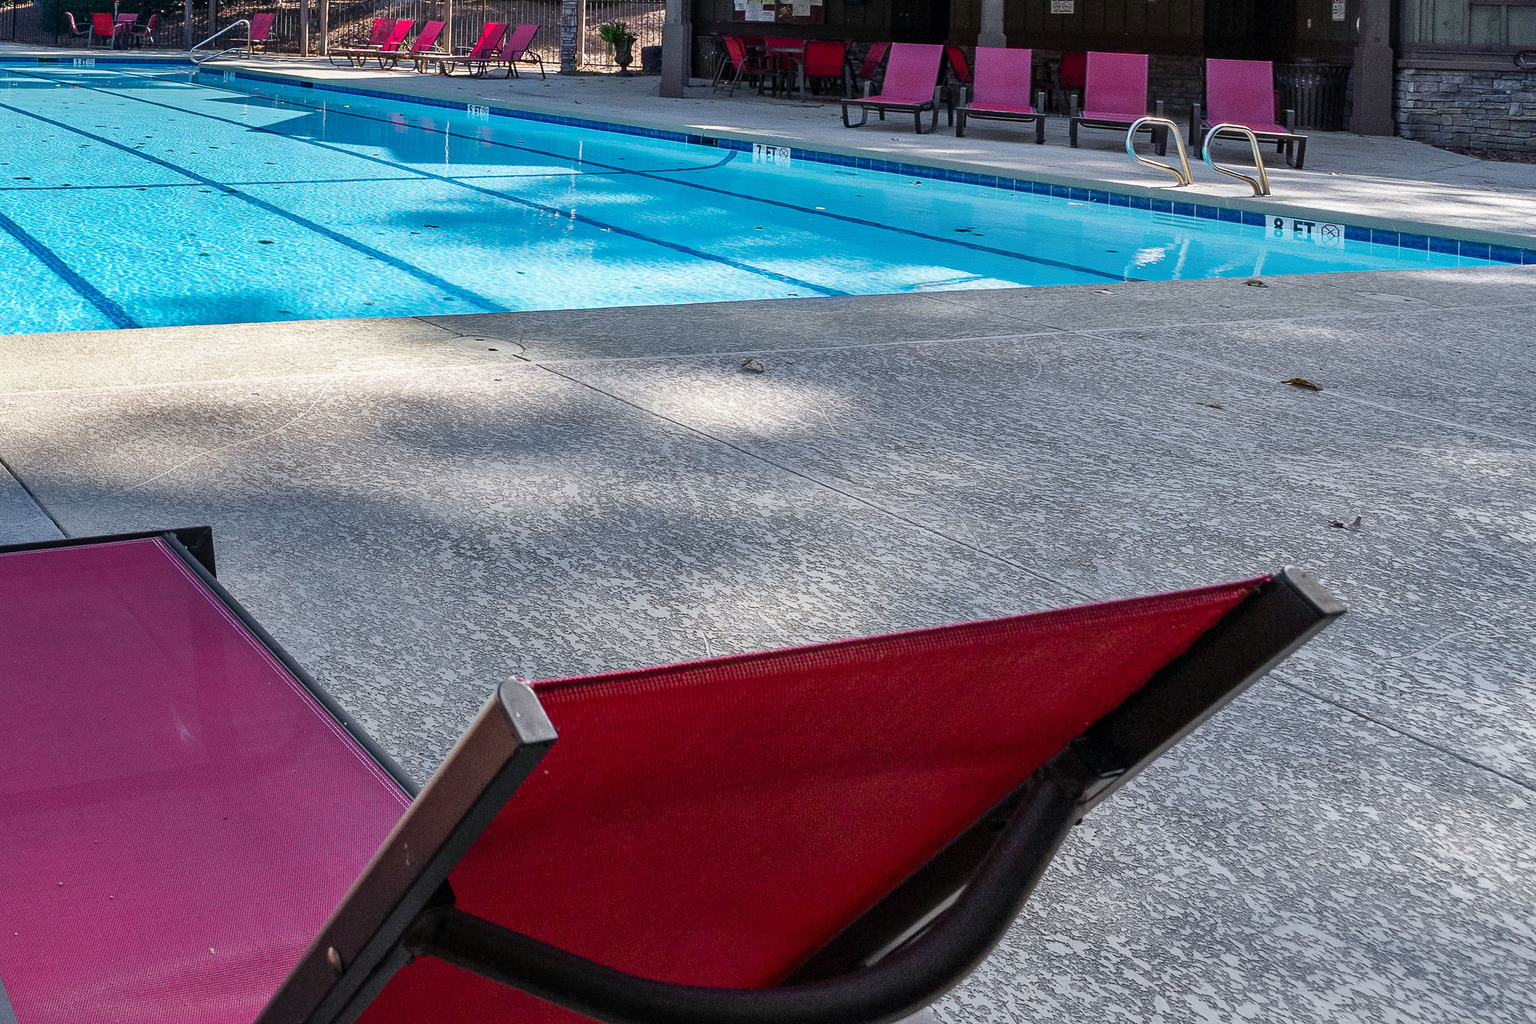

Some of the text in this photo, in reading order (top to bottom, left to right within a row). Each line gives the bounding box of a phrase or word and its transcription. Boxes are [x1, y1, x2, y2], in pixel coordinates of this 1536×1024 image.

[756, 145, 777, 156] 7 FT
[1293, 220, 1316, 234] FT
